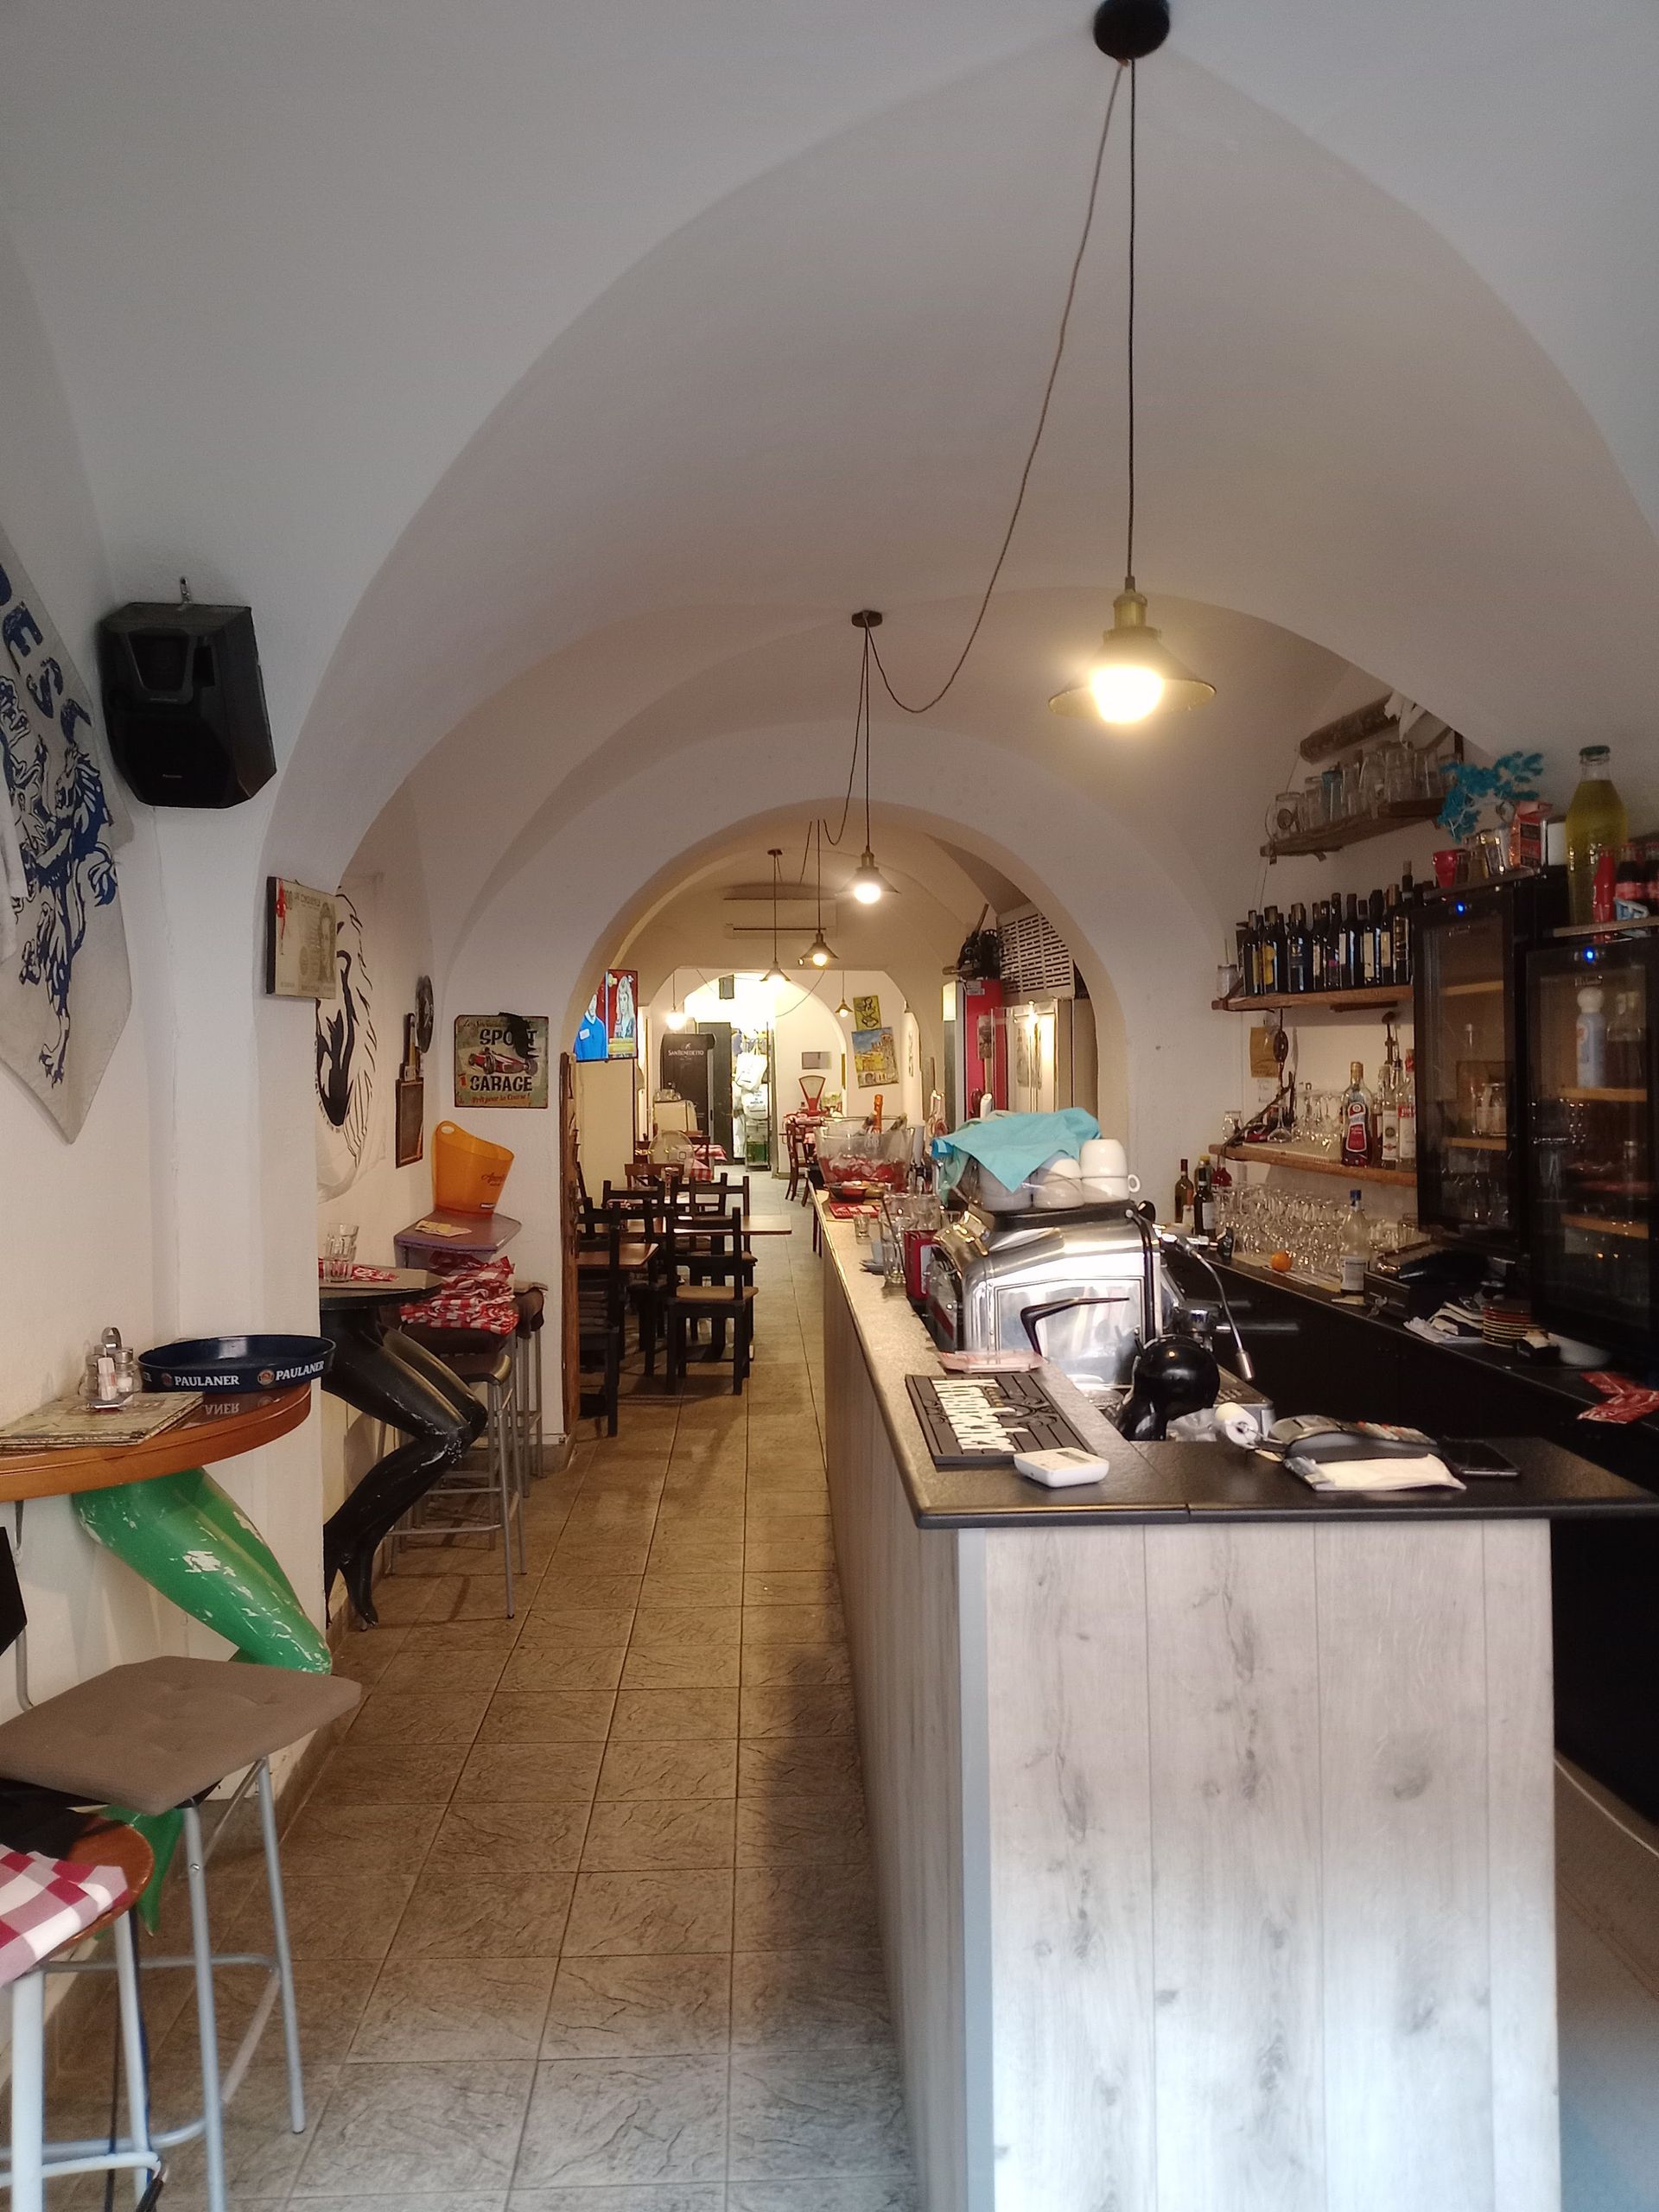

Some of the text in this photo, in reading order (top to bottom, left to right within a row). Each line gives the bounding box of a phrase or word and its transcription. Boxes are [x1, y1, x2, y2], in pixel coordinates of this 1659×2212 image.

[480, 1028, 537, 1046] SPOT
[470, 1076, 532, 1091] GARAGE
[174, 1360, 325, 1387] PAULANER PAULANER
[931, 1378, 1029, 1452] Krombacher
